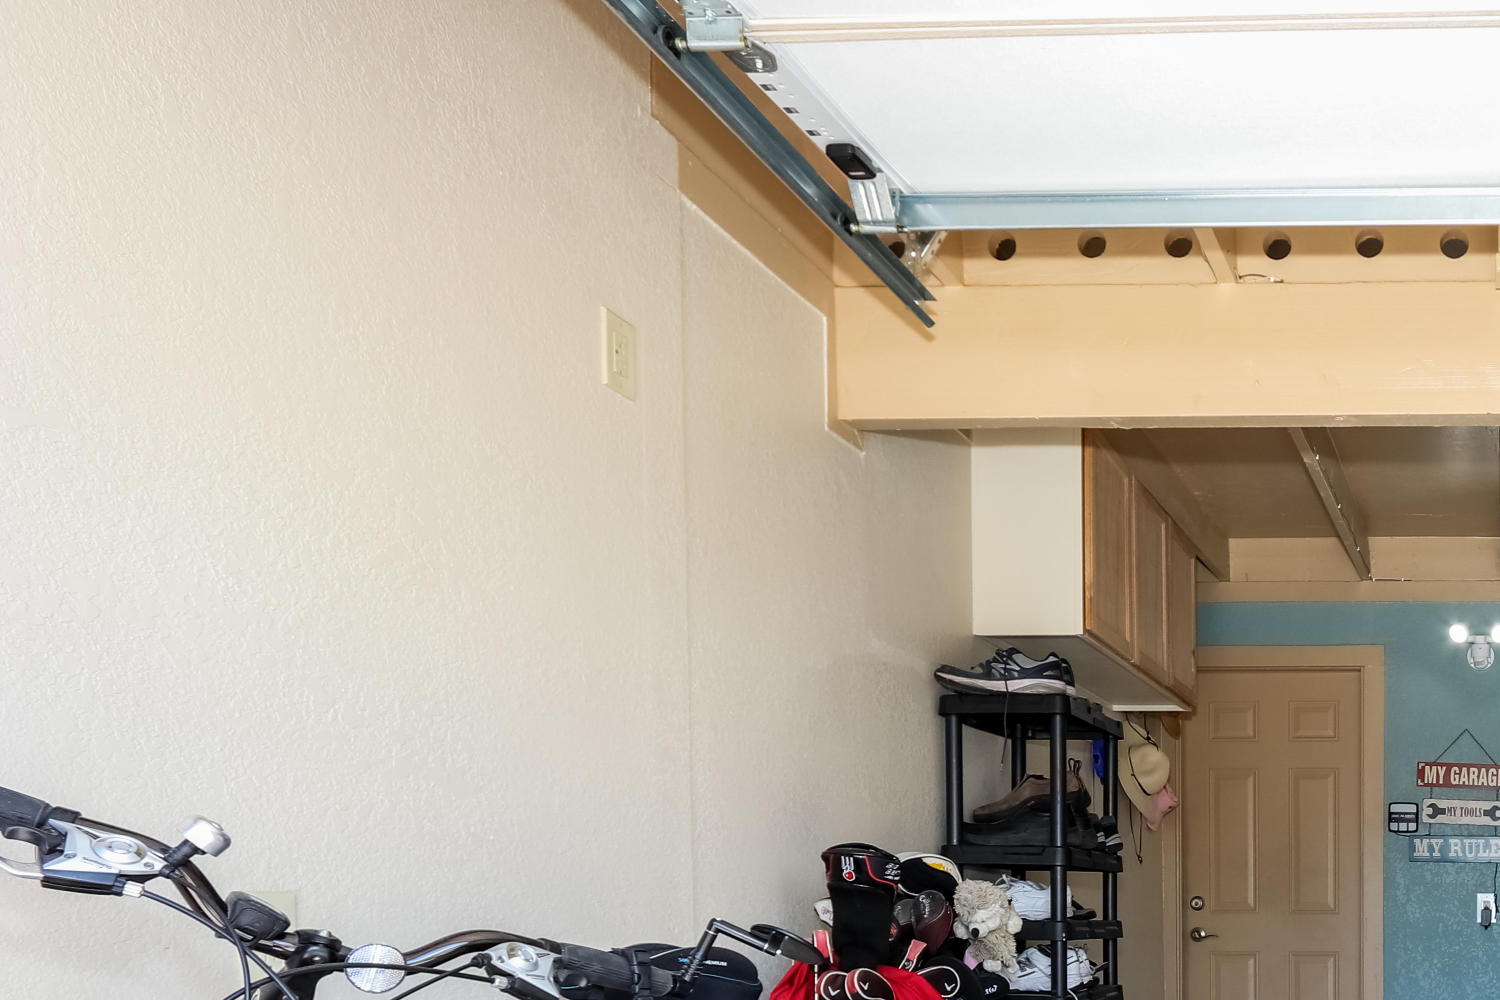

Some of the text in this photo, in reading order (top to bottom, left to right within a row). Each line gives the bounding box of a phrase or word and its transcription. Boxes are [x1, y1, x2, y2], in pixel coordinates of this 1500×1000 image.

[1424, 765, 1446, 785] MY
[1446, 806, 1483, 818] MY TOOLS
[1413, 838, 1444, 857] MY
